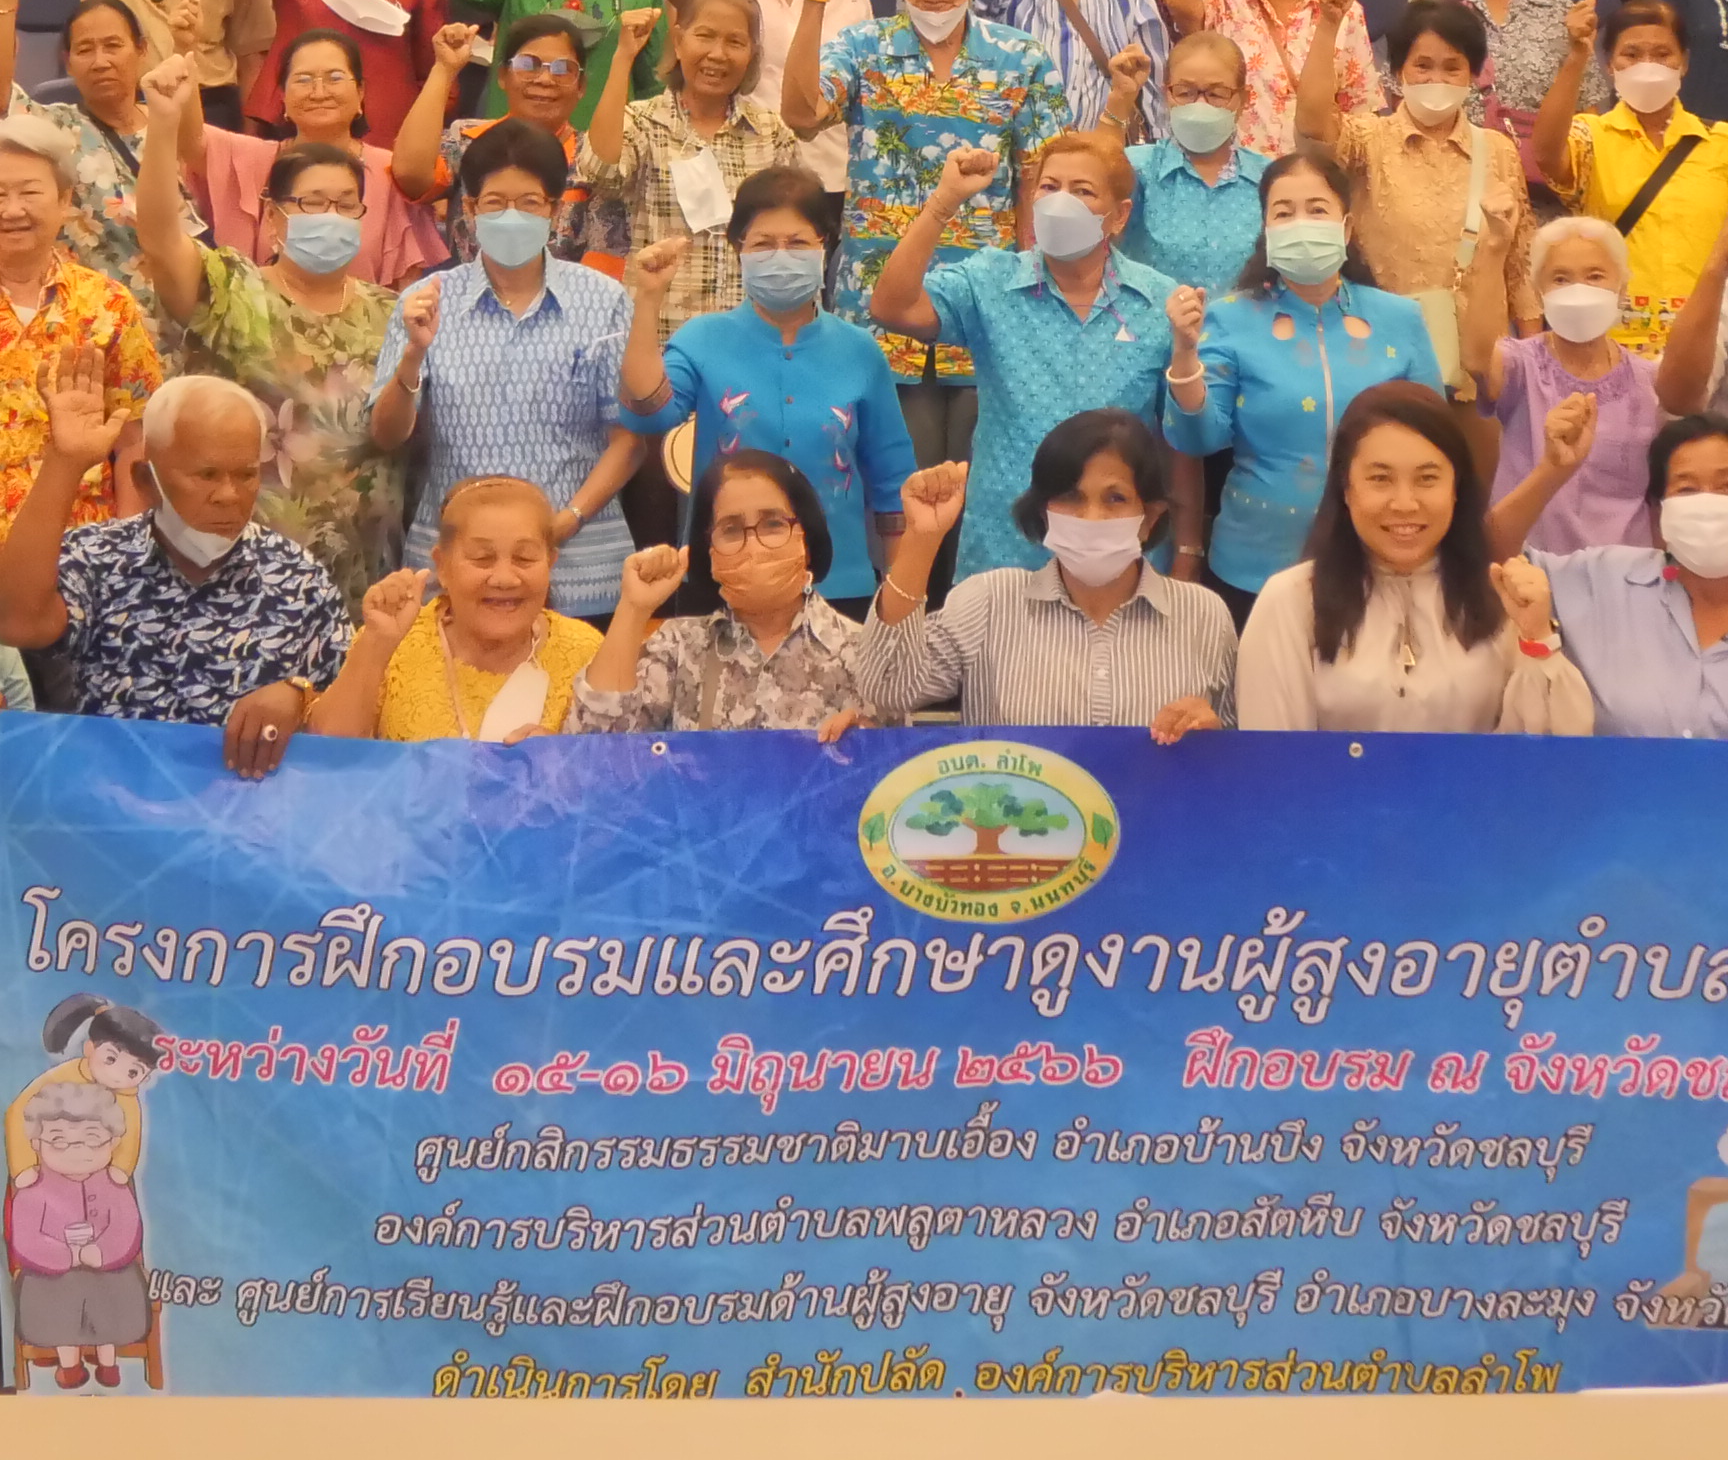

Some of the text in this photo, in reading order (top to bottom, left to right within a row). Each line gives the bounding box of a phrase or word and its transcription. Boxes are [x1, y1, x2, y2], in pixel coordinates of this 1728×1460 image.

[937, 749, 1043, 777] อบต. ลำโพ
[152, 1017, 460, 1093] ระหว่างวันที่
[492, 1051, 687, 1096] ๑๕-๑๖
[707, 1033, 941, 1116] มิถุนายน
[953, 1041, 1123, 1089] ๒๕๖๖
[1182, 1026, 1415, 1090] ฝึกอบรม
[1427, 1049, 1489, 1093] ณ
[414, 1100, 1595, 1184] ศูนย์กสิกรรมธรรมชาติมาบเอื้อง อำเภอบ้านบึง จังหวัดชลบุรี
[375, 1192, 1629, 1259] องค์การบริหารส่วนตำบลพลูตาหลวง อำเภอสัตหีบ จังหวัดชลบุรี
[147, 1269, 223, 1308] และ
[236, 1265, 1015, 1337] ศูนย์การเรียนรู้และฝึกอบรมด้านผู้สูงอายุ
[1029, 1267, 1285, 1329] จังหวัดชลบุรี
[1295, 1268, 1597, 1334] อำเภอบางละมุง
[433, 1344, 1562, 1399] ดำเนินการโดย สำนักปลัด องค์การบริหารส่วนตำบลลำโพ
